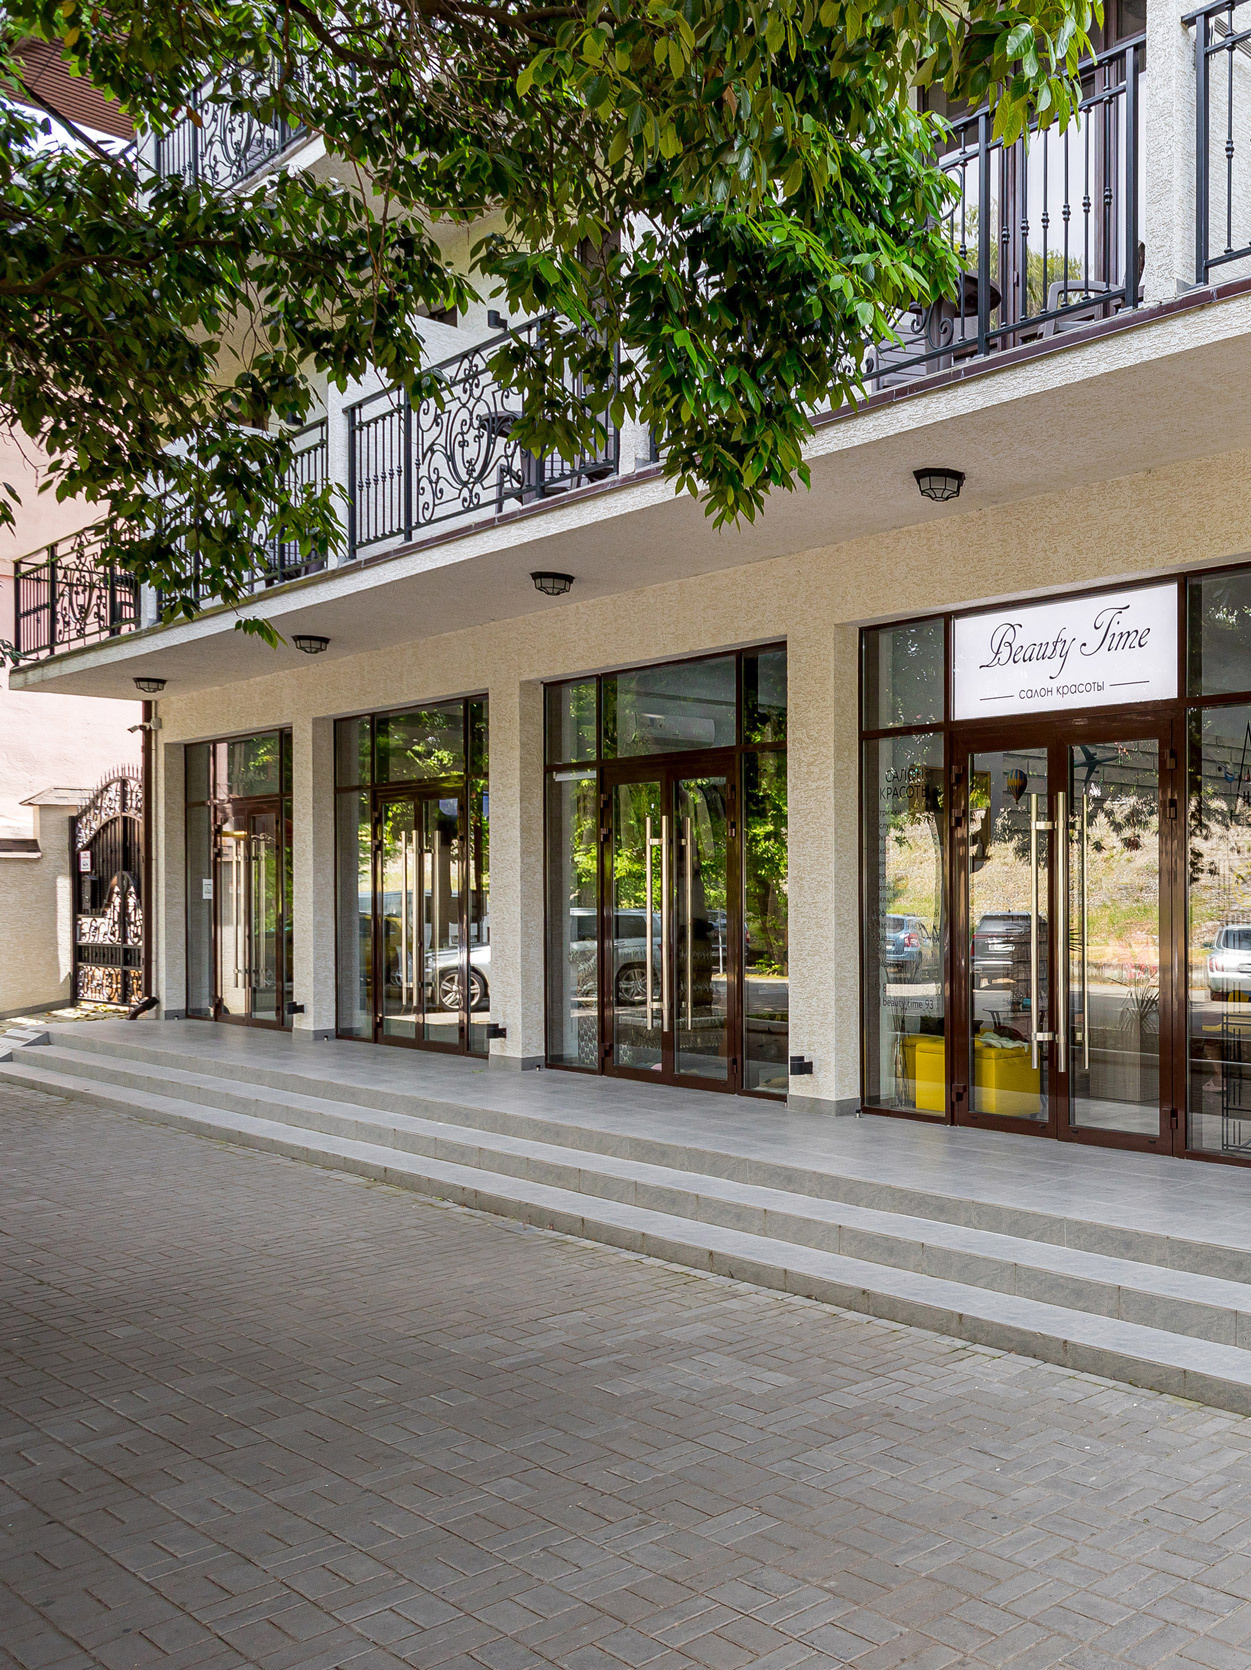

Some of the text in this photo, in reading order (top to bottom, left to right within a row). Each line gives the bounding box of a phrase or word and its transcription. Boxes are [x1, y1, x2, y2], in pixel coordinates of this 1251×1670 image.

[978, 604, 1151, 680] Beauty Time
[1018, 680, 1105, 700] салон красоты
[884, 767, 925, 783] САЛОН
